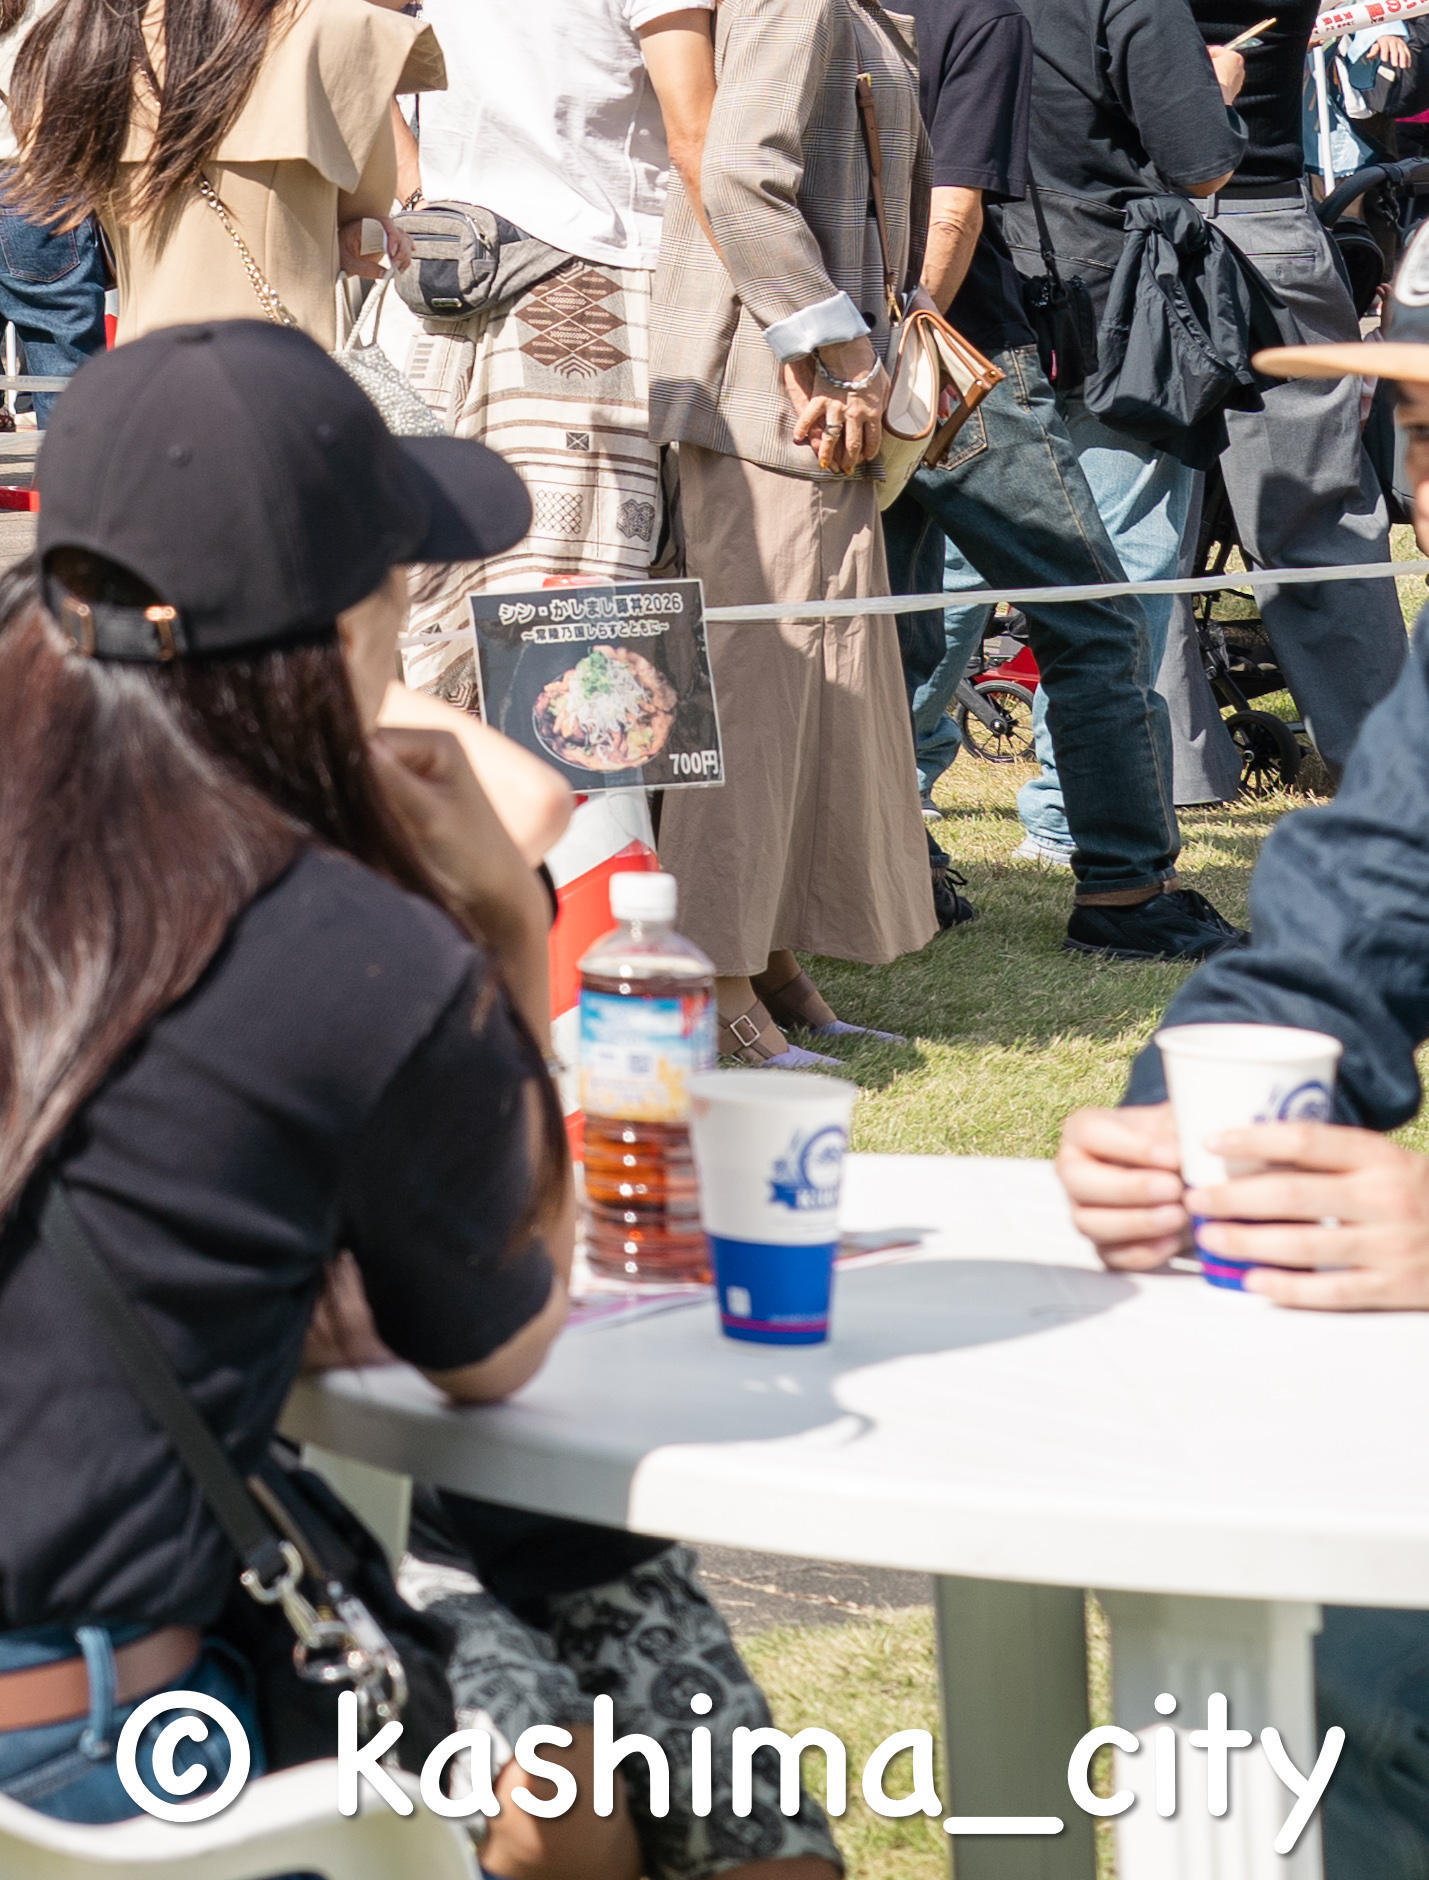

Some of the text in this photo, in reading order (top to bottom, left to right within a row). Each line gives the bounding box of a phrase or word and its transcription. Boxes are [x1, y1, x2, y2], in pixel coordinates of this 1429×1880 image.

[498, 593, 683, 624] シン・かしまし豚丼2026
[669, 750, 719, 775] 700円
